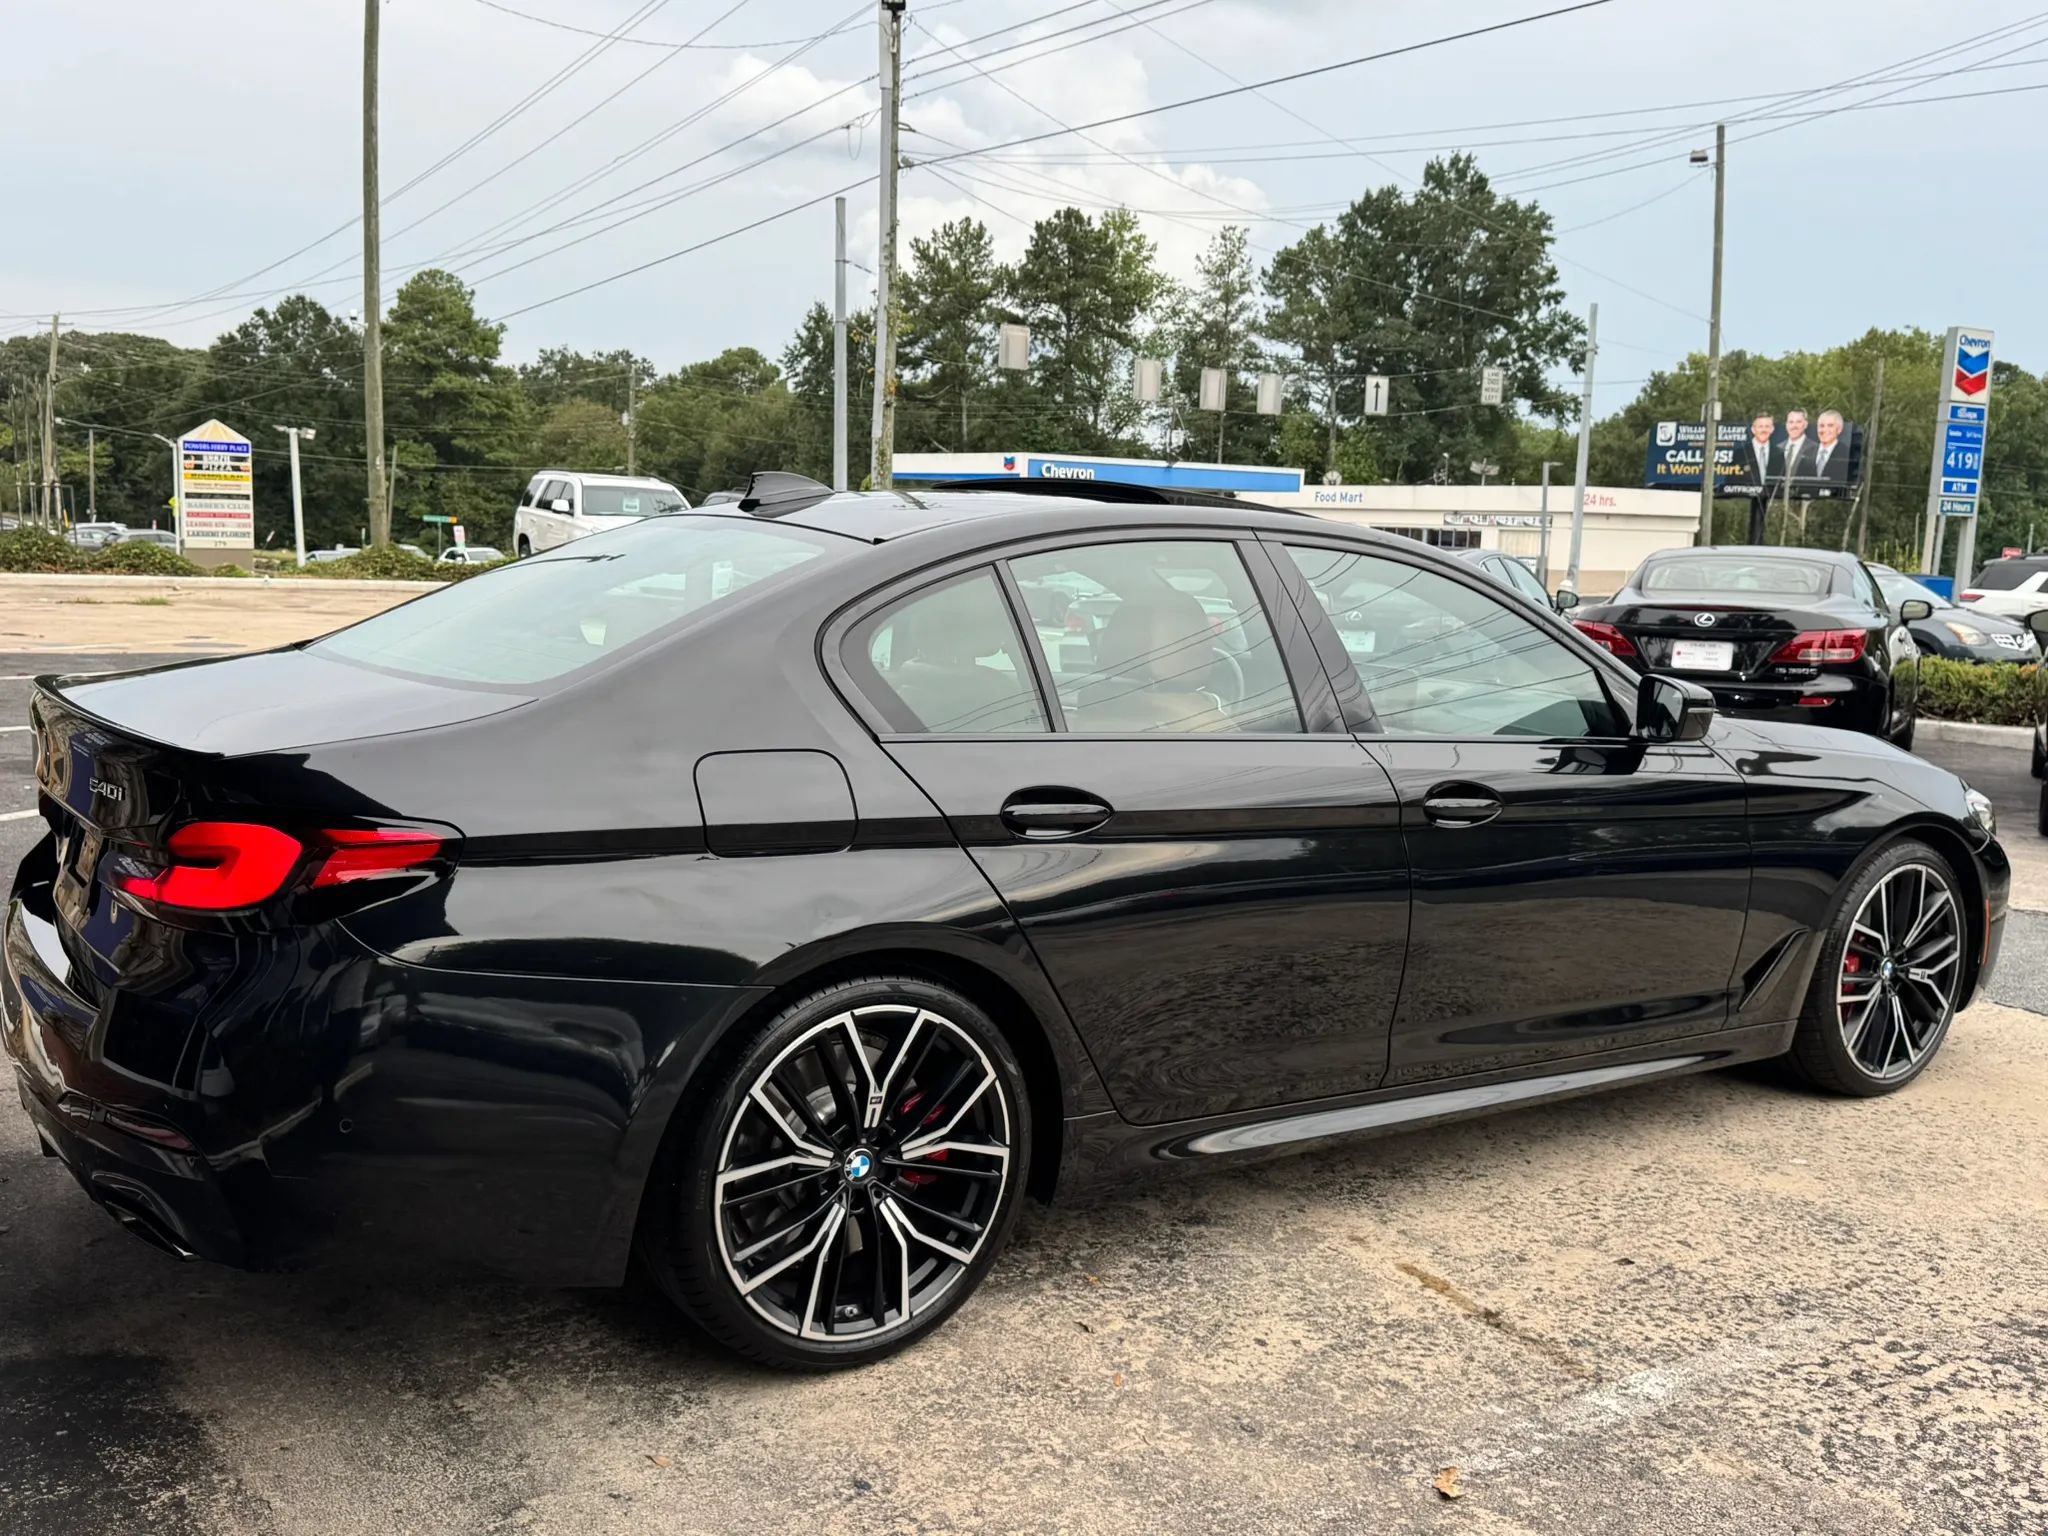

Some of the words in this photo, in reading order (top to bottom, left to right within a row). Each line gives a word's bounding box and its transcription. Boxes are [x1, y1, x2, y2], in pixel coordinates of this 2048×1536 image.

[1960, 335, 1991, 348] Chevron
[1665, 450, 1704, 462] CALL
[203, 463, 232, 471] PIZZA
[1041, 463, 1095, 480] Chevron
[1657, 464, 1667, 474] It
[1671, 464, 1703, 474] Won'
[1952, 482, 1967, 492] ATM
[1315, 491, 1336, 502] Food
[1340, 492, 1362, 503] Mart
[1584, 494, 1597, 505] 24
[1600, 494, 1617, 507] hrs.
[1942, 501, 1951, 511] 24
[1953, 502, 1971, 512] Hours
